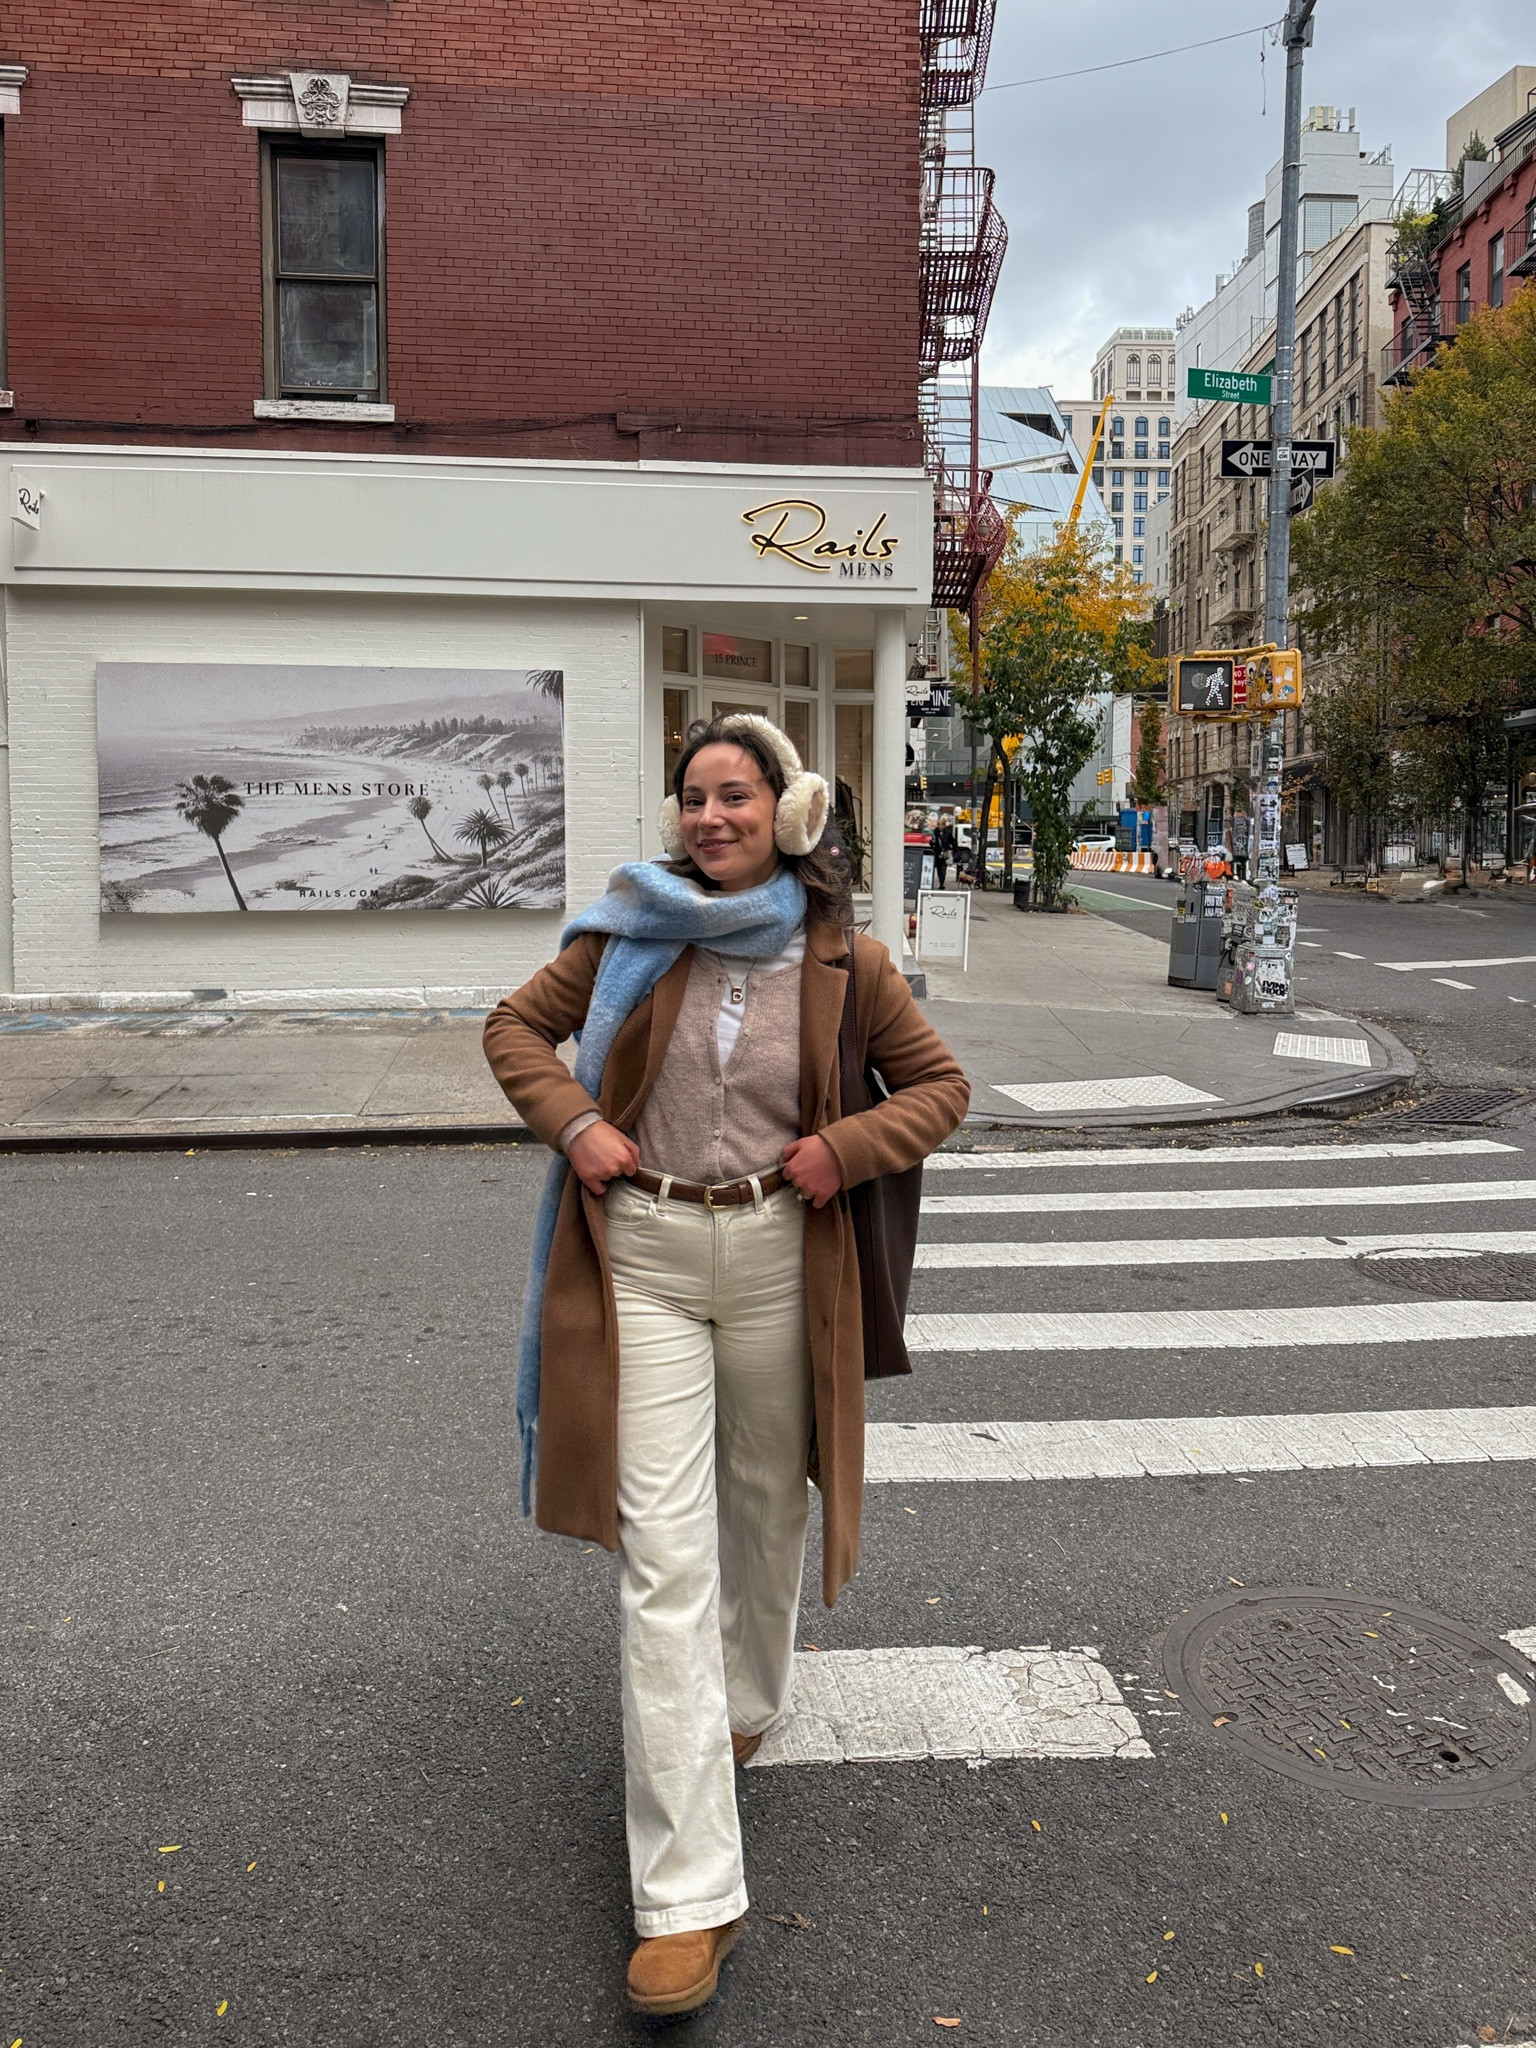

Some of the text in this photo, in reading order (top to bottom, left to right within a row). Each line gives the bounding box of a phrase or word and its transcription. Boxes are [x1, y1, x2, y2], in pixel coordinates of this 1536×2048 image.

[1204, 372, 1257, 392] Elizabeth
[1221, 389, 1240, 400] Street
[1239, 451, 1271, 466] ONE
[18, 487, 40, 515] Rails
[742, 499, 899, 570] Rails
[839, 561, 894, 577] MENS
[715, 653, 758, 668] 15 PRINCE
[905, 685, 928, 696] Rails
[243, 782, 429, 797] THE MENS STORE
[299, 889, 379, 898] RAILS.COM
[929, 905, 957, 919] Rails
